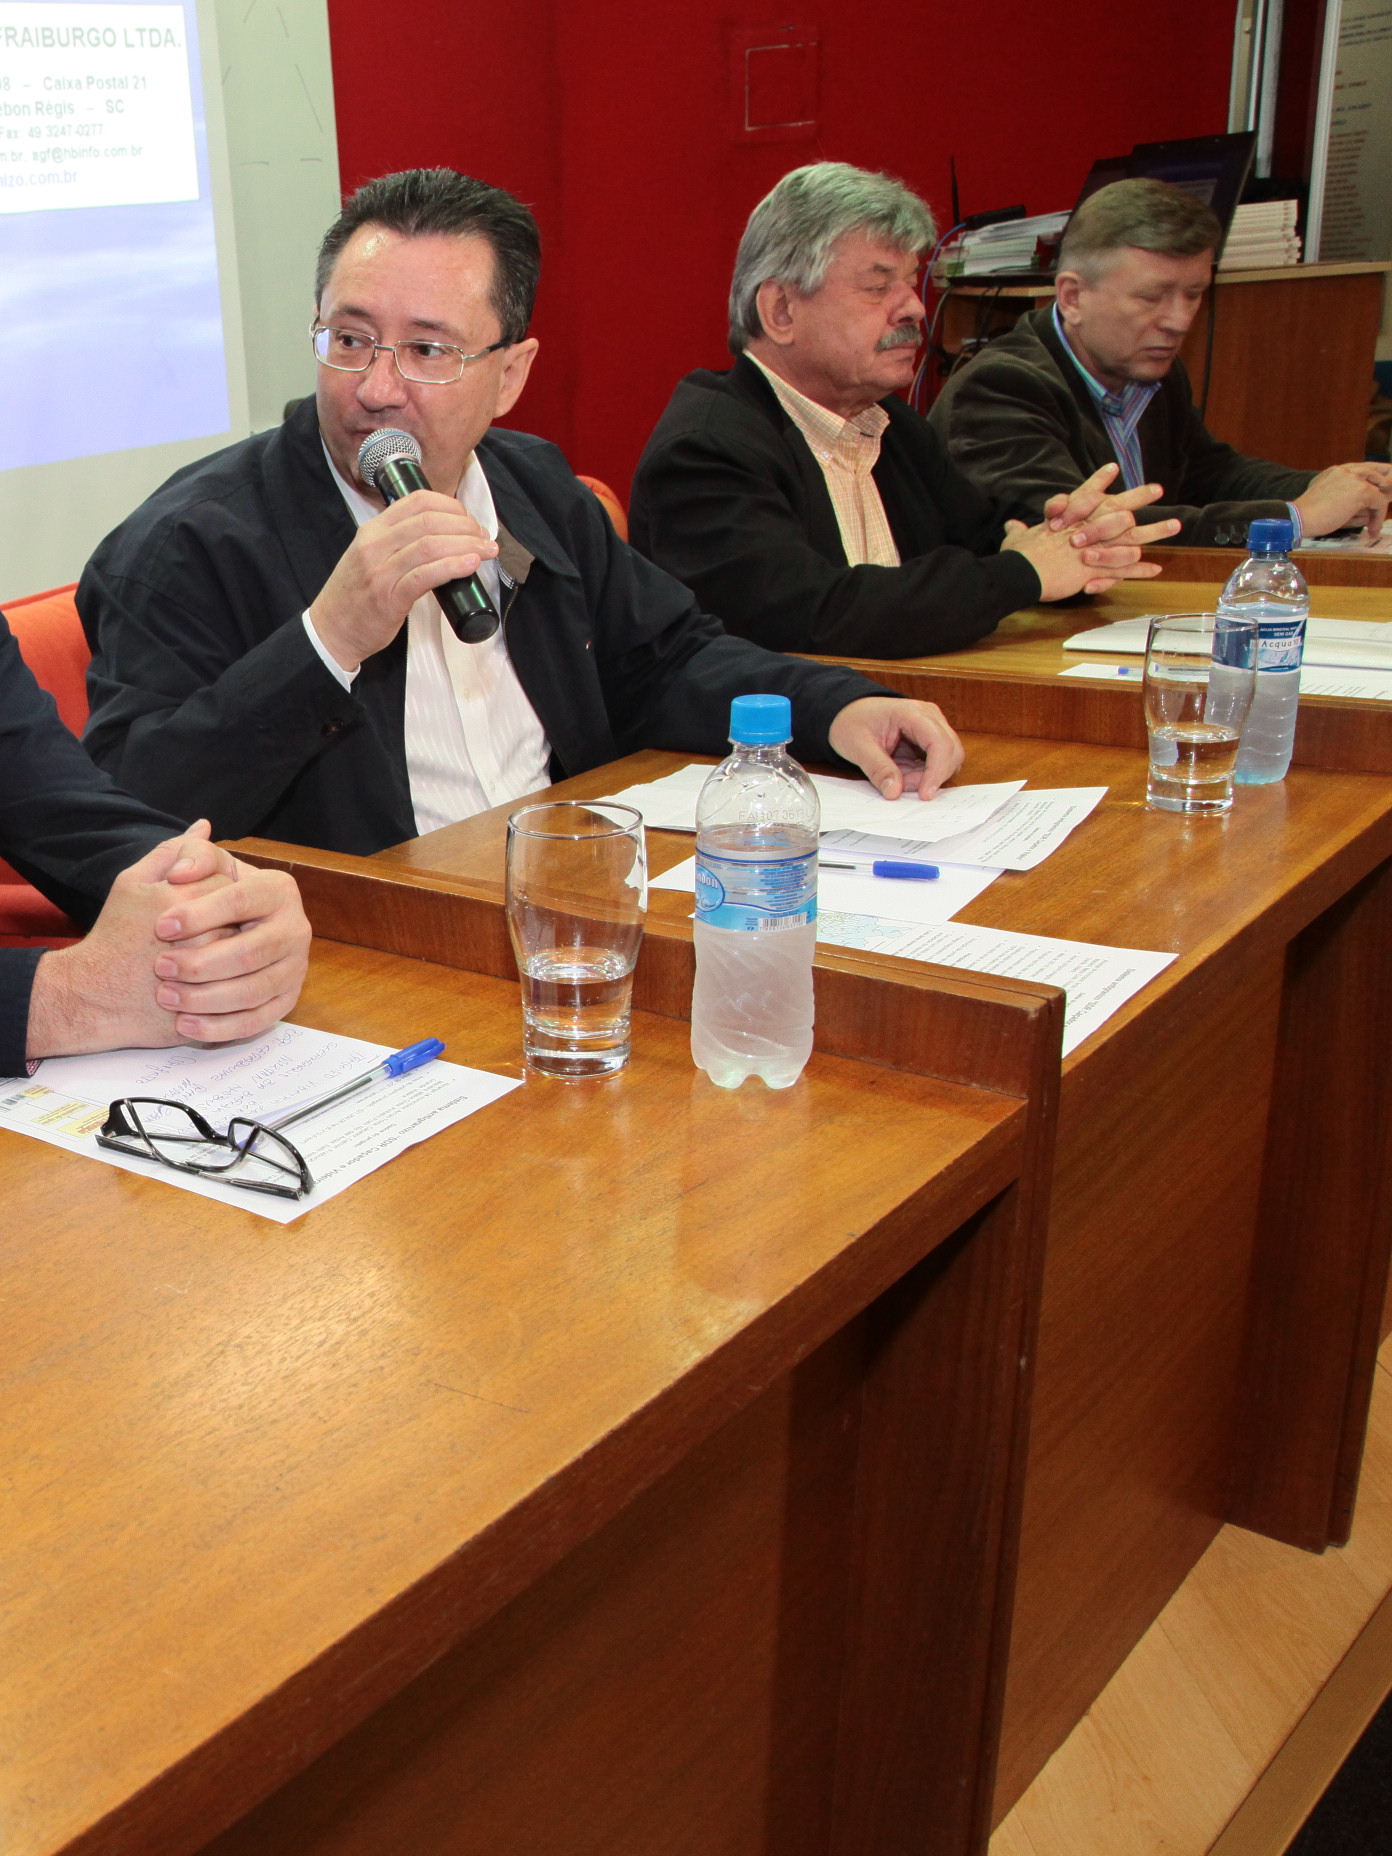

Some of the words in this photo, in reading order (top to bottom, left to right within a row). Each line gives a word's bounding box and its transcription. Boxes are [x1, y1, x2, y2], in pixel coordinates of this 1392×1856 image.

[124, 27, 180, 48] LTDA.
[43, 76, 82, 90] Caixa
[86, 75, 128, 89] Postal
[133, 75, 146, 89] 21
[35, 100, 74, 119] Régis
[106, 99, 124, 113] SC
[28, 126, 41, 138] 49
[46, 123, 103, 137] 3247-0277
[32, 145, 143, 163] agf@hbinfo.com.br
[1261, 641, 1292, 649] Acqua
